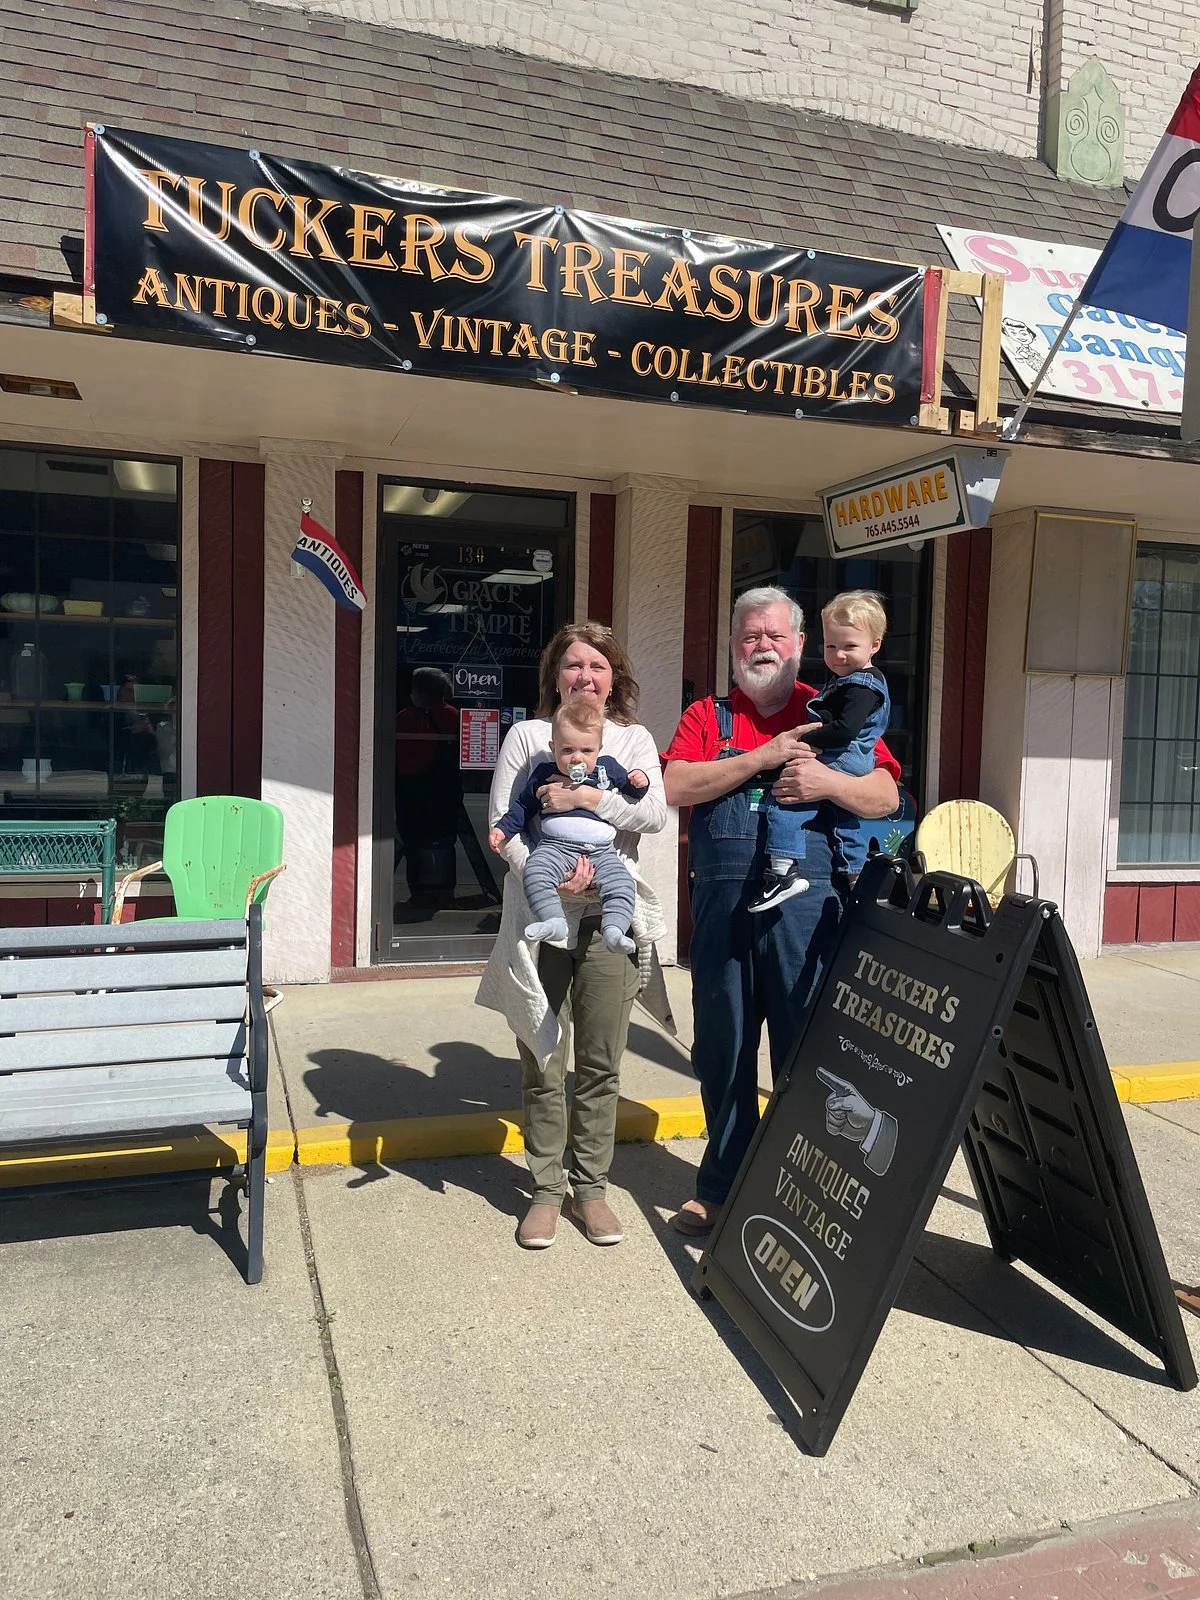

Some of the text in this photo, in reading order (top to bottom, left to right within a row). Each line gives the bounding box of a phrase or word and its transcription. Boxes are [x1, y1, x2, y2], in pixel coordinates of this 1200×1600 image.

[139, 168, 901, 343] TUCKERS TREASURES
[132, 267, 372, 339] ANTIQUES
[411, 308, 598, 367] VINTAGE
[631, 341, 896, 405] COLLECTIBLES
[1036, 324, 1186, 378] Banq
[835, 471, 948, 527] HARDWARE
[865, 514, 920, 538] 765.445.5544
[297, 536, 358, 599] ANTIQUES
[458, 546, 484, 564] 130
[446, 612, 533, 644] TEMPLE
[453, 580, 533, 614] GRACE
[455, 668, 500, 690] Open
[854, 950, 960, 1024] TUCKER'S
[832, 981, 956, 1070] TREASURES
[786, 1132, 870, 1221] ANTIQUES
[774, 1168, 853, 1262] VINTAGE
[754, 1232, 820, 1311] OPEN
